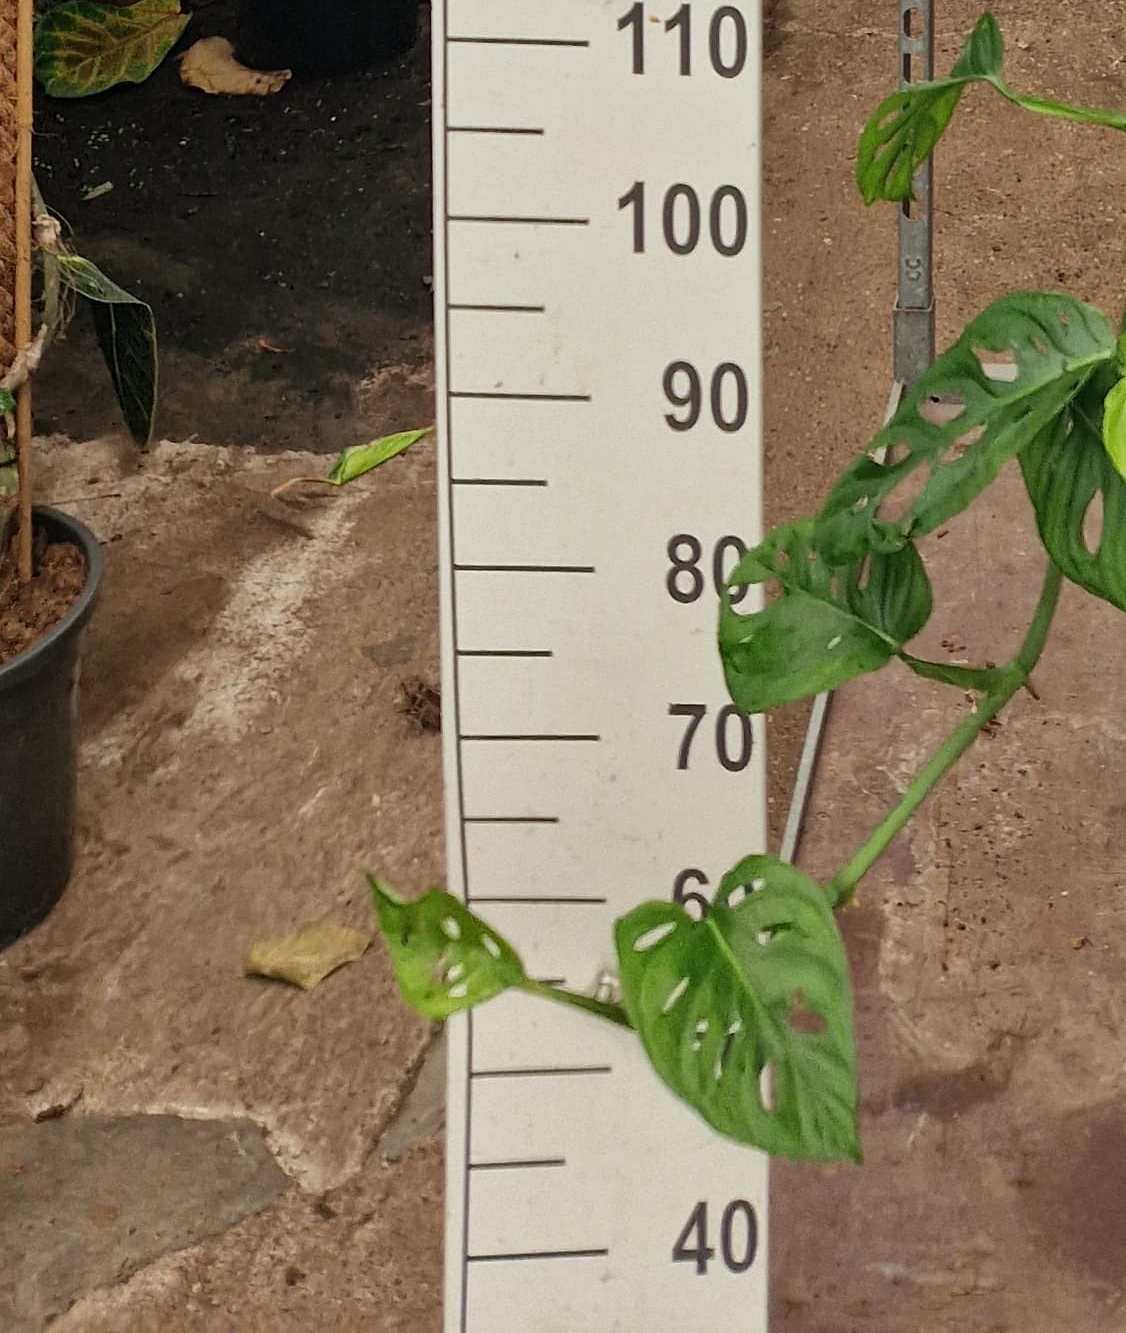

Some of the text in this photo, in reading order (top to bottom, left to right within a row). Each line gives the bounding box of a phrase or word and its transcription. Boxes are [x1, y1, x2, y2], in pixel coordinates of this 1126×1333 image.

[616, 2, 748, 79] 110
[617, 181, 748, 257] 100
[662, 360, 748, 433] 90
[666, 533, 749, 606] 80
[668, 703, 753, 773] 70
[672, 1200, 758, 1275] 40
